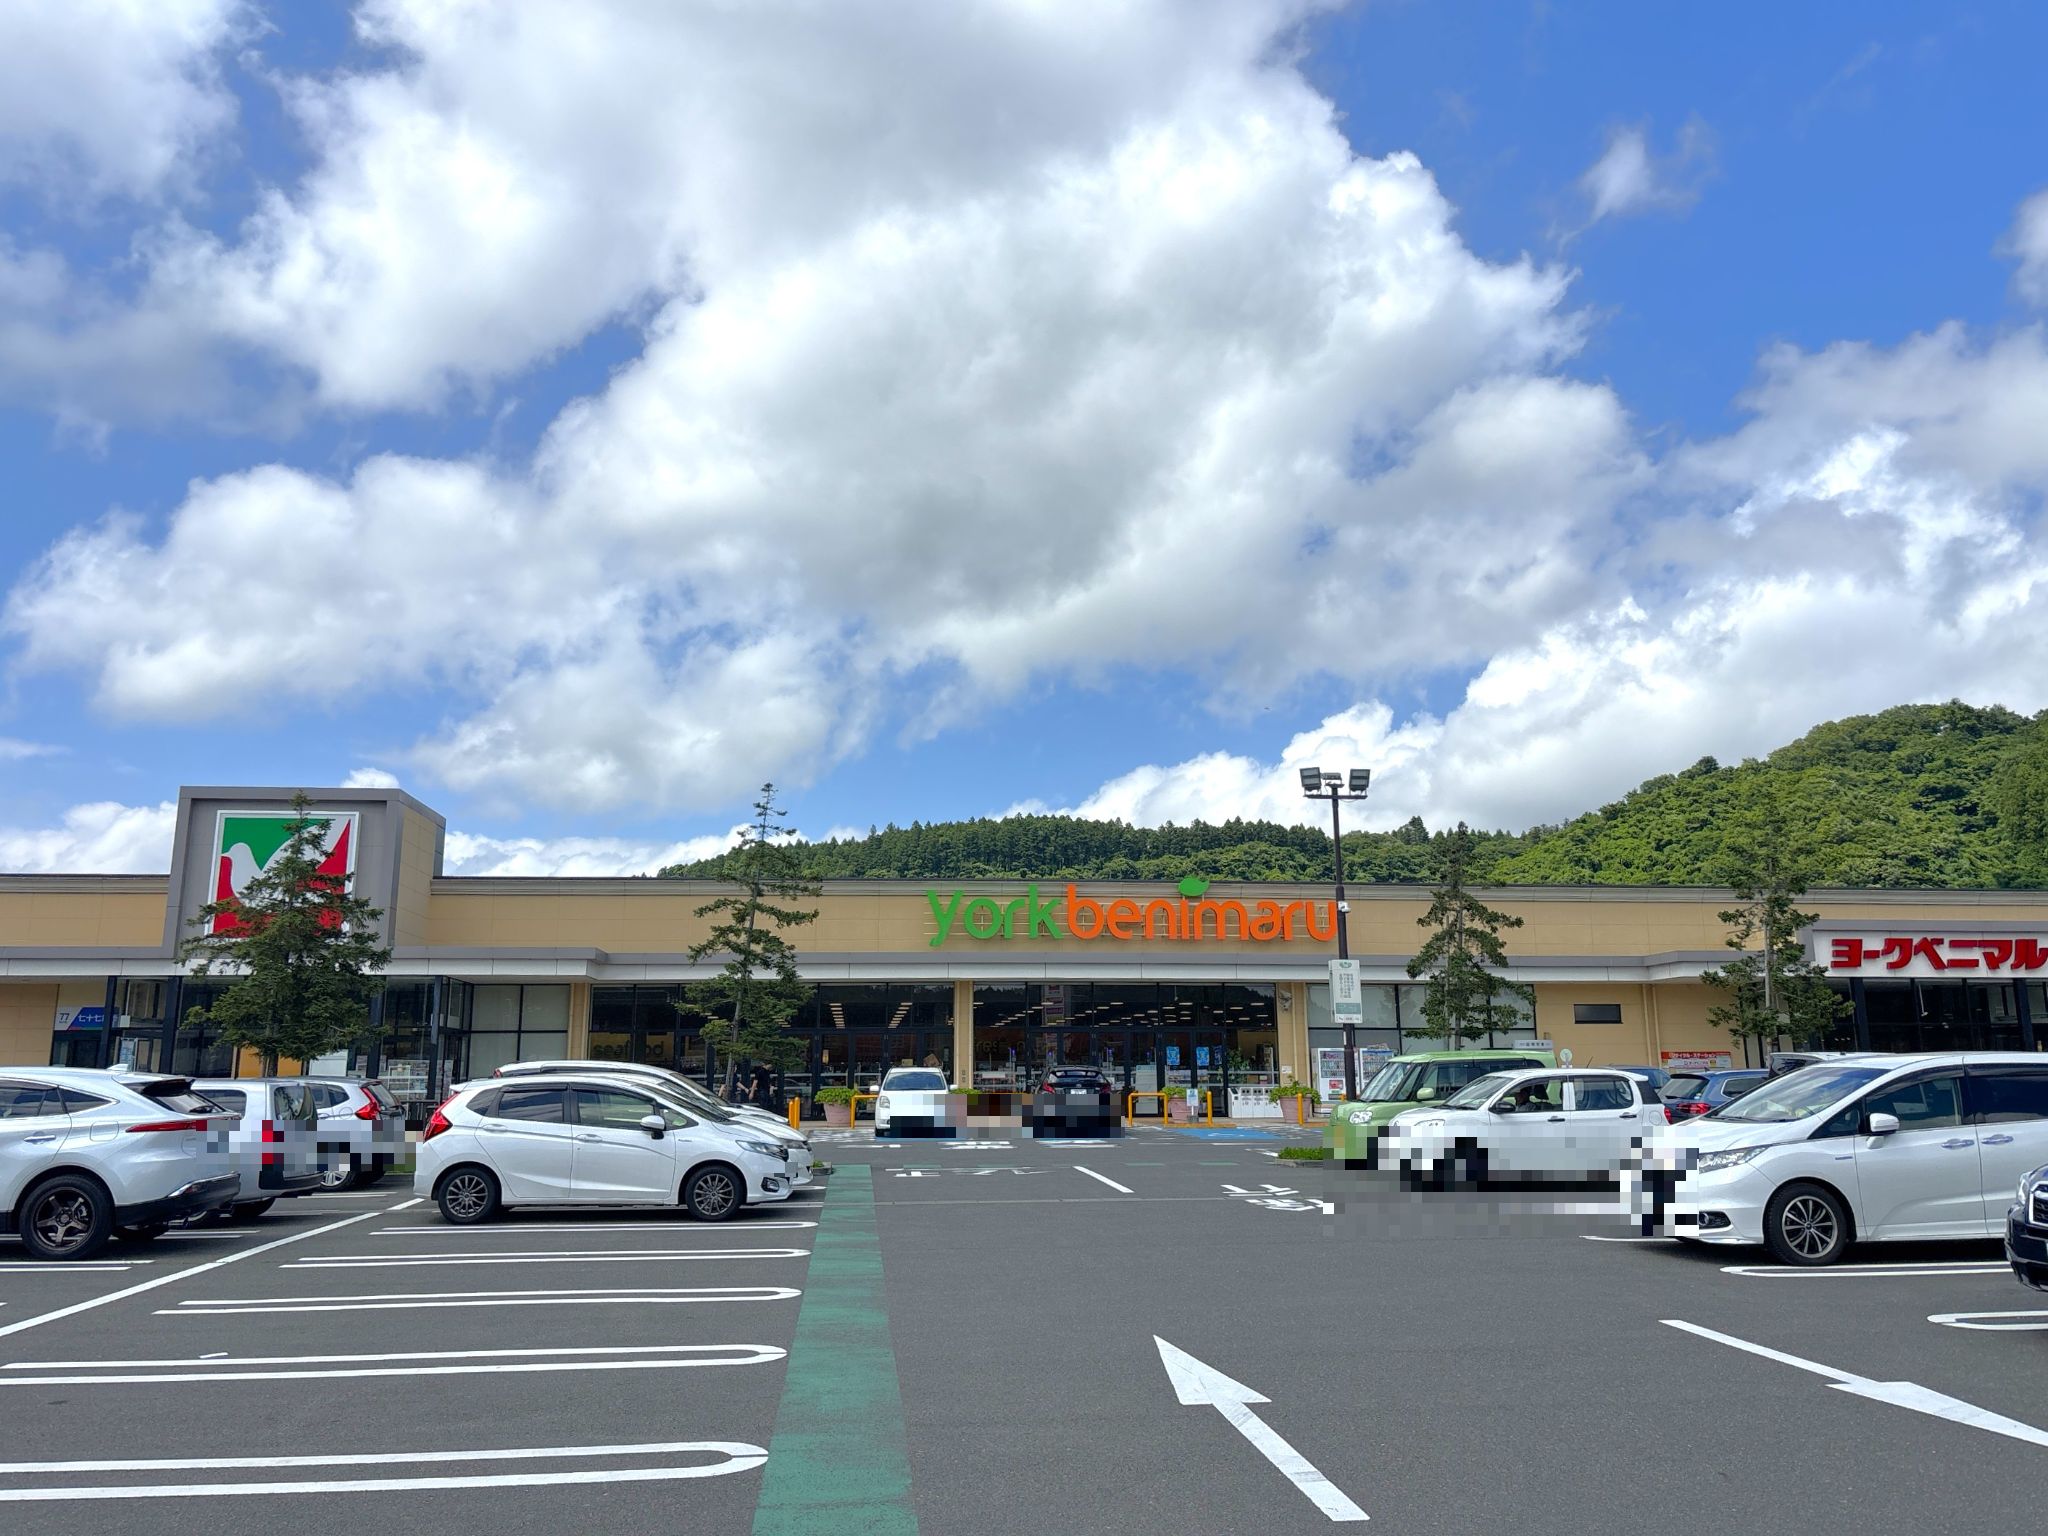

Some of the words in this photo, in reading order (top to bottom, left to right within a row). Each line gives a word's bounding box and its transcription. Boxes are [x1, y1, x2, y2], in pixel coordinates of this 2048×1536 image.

[926, 882, 1338, 947] yorkbenimaru
[1831, 937, 2048, 970] ヨークベニマル
[78, 1014, 104, 1023] 七十七
[593, 1039, 665, 1056] seafd
